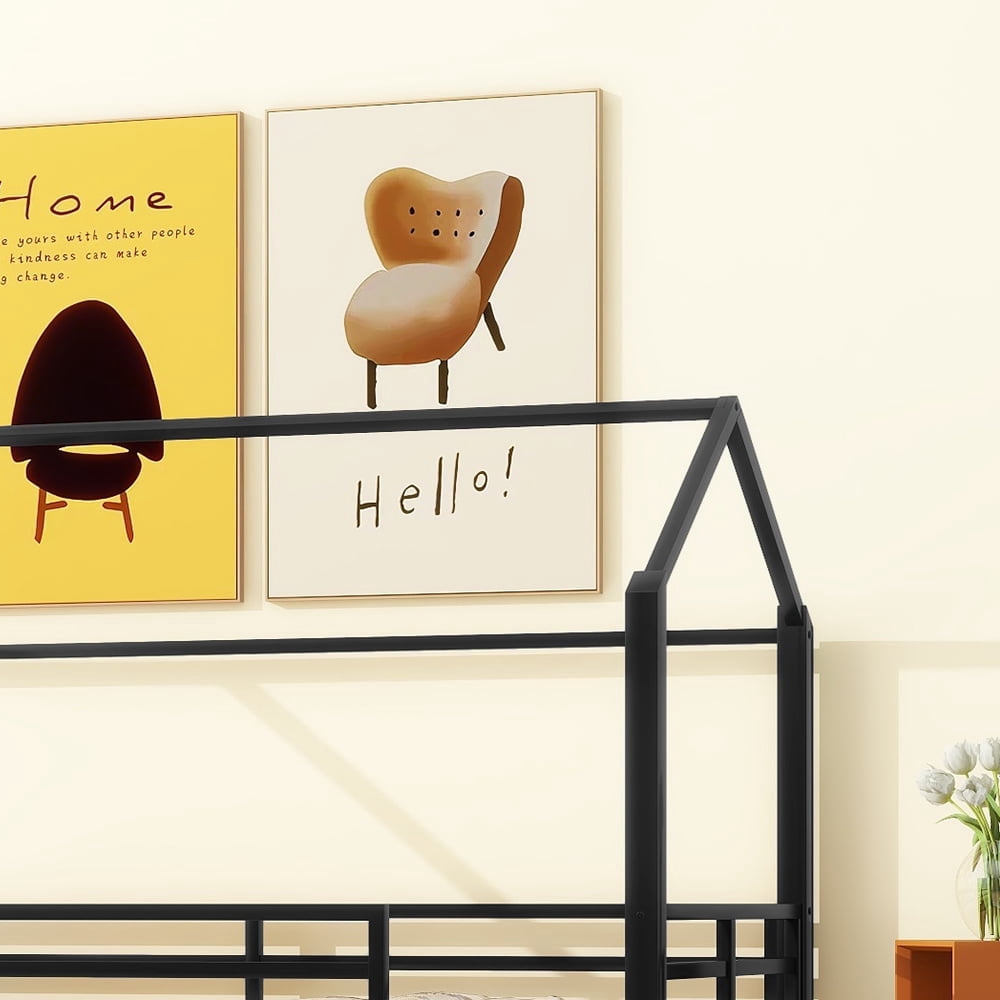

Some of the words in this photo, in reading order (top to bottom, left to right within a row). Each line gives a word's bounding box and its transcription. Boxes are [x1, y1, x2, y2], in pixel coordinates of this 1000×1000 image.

[17, 235, 57, 248] yours
[66, 229, 99, 242] with
[106, 228, 143, 241] other
[151, 225, 196, 241] people
[10, 250, 77, 264] kindness
[85, 251, 108, 261] can
[116, 246, 148, 259] make
[17, 270, 70, 283] change.
[356, 446, 515, 528] Hello!
